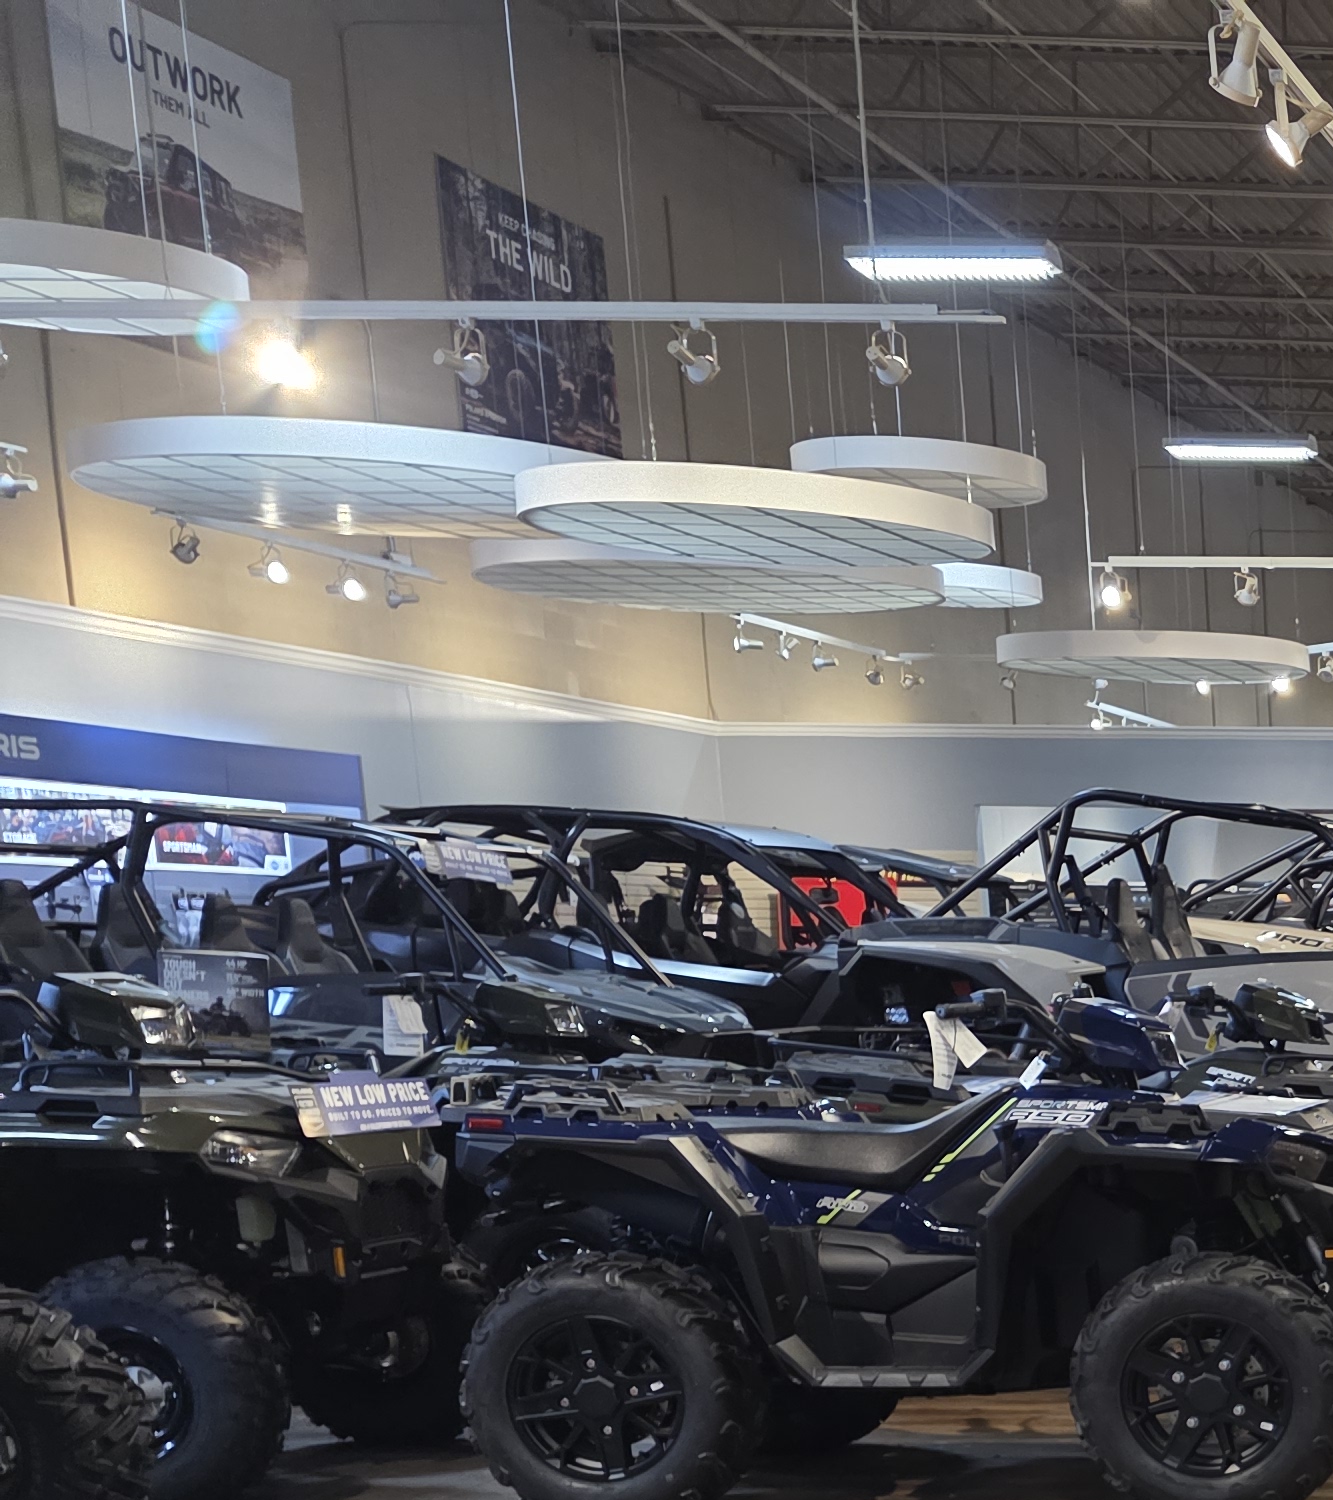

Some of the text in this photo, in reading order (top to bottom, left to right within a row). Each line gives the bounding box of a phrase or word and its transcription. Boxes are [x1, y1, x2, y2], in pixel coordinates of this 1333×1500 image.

[108, 26, 244, 119] OUTWORK
[152, 89, 185, 118] THEM
[486, 228, 573, 293] THE WILD
[320, 1081, 430, 1108] NEW LOW PRICE
[328, 1110, 349, 1122] BUILT
[350, 1109, 361, 1120] TO
[375, 1107, 402, 1118] PRICED
[402, 1106, 413, 1116] TO
